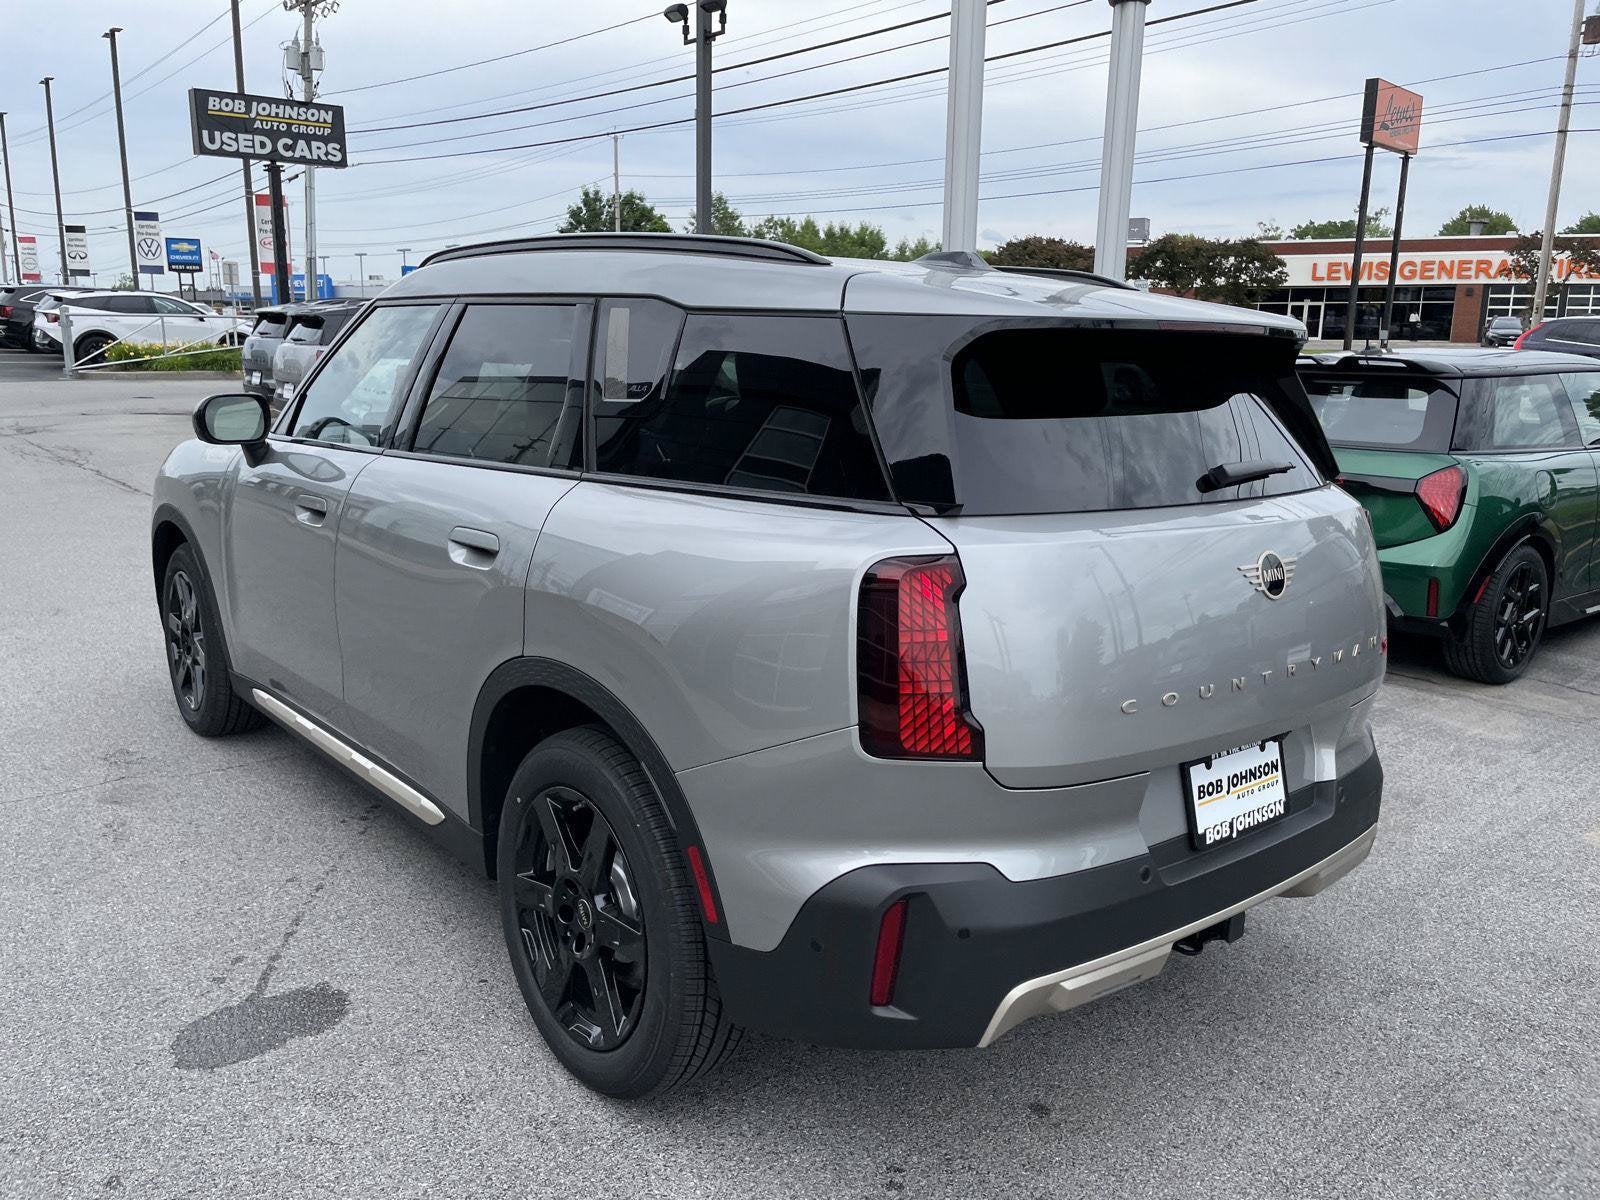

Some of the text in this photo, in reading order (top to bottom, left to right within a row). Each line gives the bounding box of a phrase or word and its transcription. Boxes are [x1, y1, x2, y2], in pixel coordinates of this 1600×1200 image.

[208, 96, 333, 124] BOB JOHNSON
[253, 120, 332, 136] AUTO GROUP
[202, 129, 343, 162] USED CARS
[1311, 261, 1391, 281] LEWIS
[1263, 567, 1284, 582] MINI
[1120, 635, 1378, 714] COUNTRYMAN
[1197, 758, 1279, 801] BOB JOHNSON
[1236, 780, 1279, 800] AUTO GROUP
[1205, 799, 1286, 845] BOB JOHNSON
